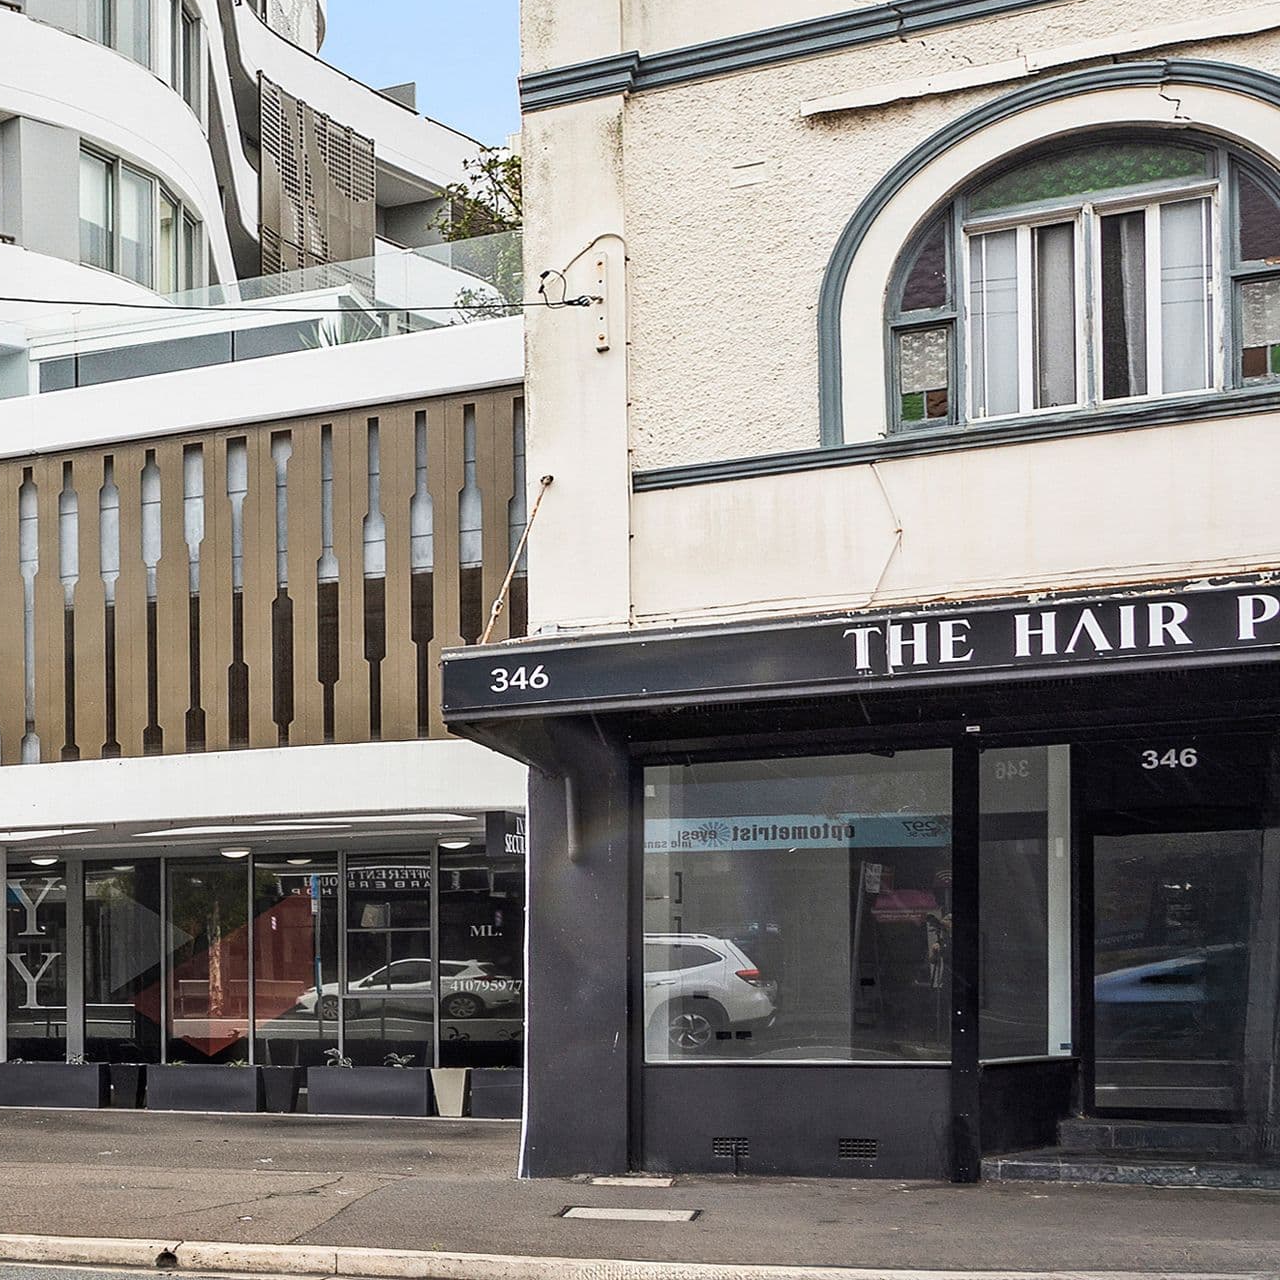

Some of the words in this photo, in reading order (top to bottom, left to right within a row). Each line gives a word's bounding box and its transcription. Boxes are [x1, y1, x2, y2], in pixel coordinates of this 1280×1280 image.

[842, 618, 975, 670] THE
[1014, 600, 1193, 658] HAIR
[490, 664, 549, 693] 346
[1141, 748, 1198, 769] 346
